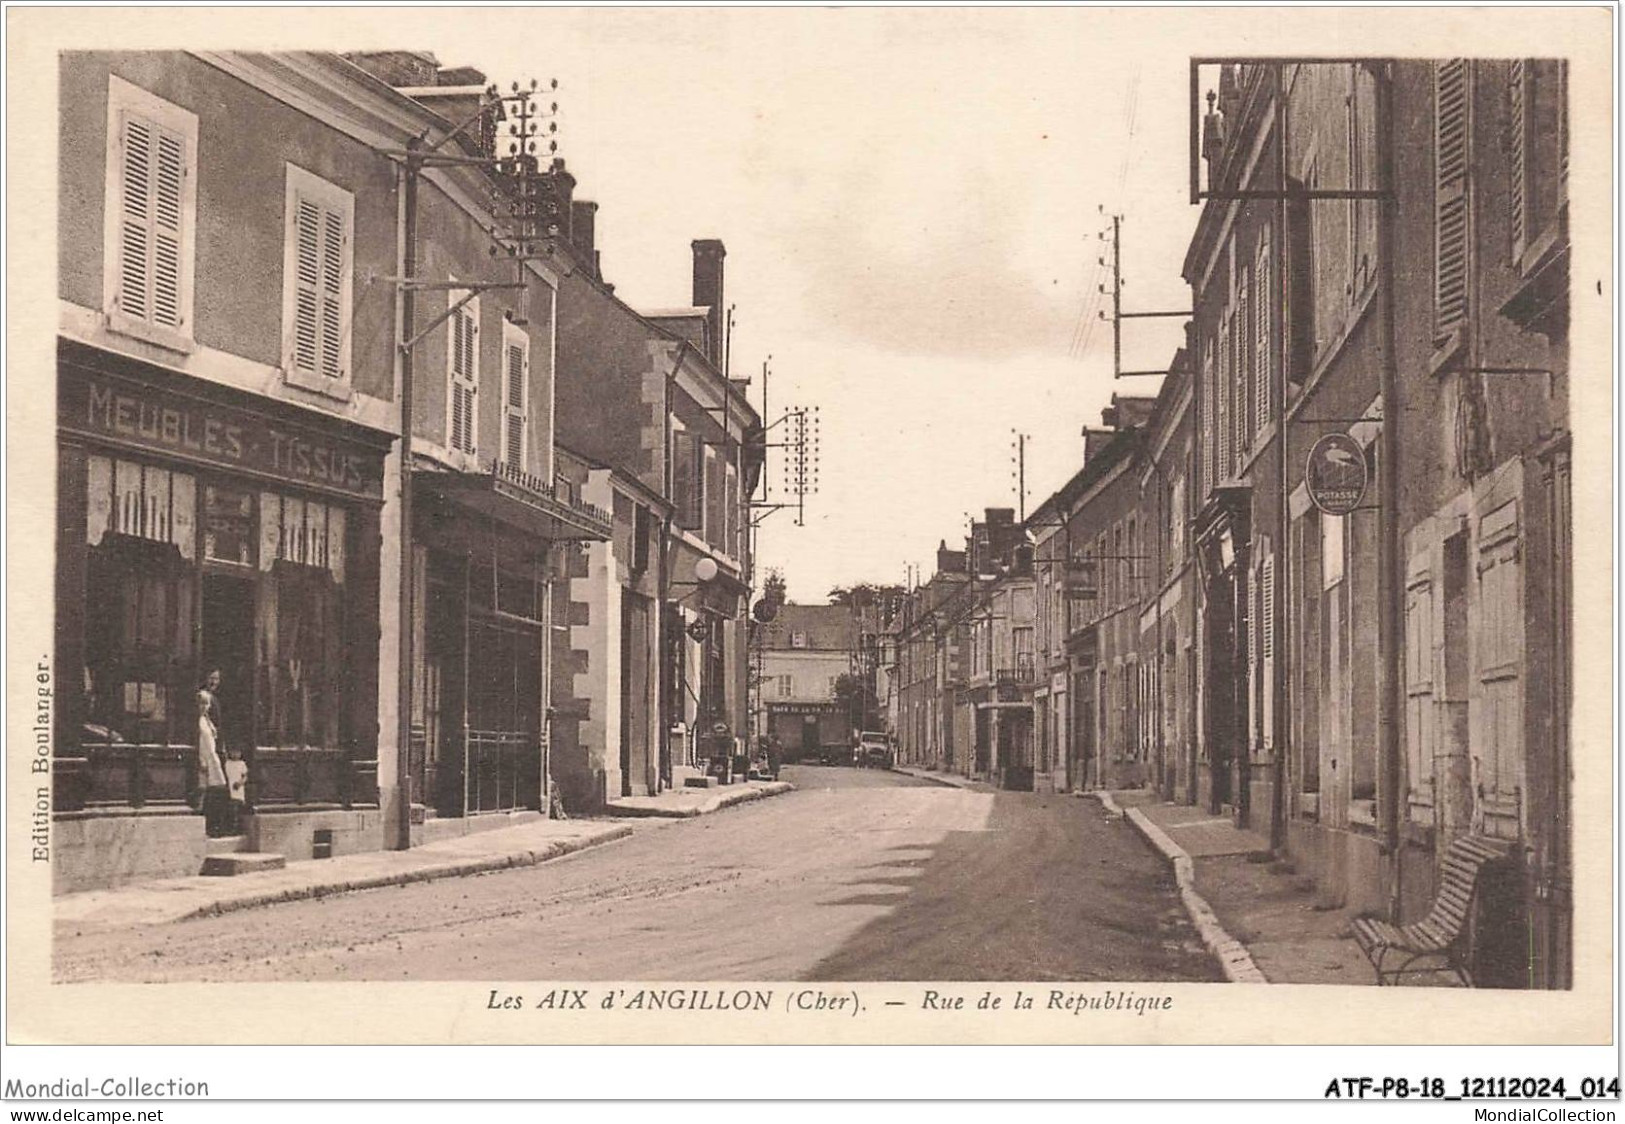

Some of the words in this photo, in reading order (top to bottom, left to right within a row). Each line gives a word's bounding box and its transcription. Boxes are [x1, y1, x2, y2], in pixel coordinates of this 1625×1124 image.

[88, 382, 242, 460] MEUBLES
[269, 429, 363, 488] TISSUS
[1317, 491, 1359, 501] POTASSE
